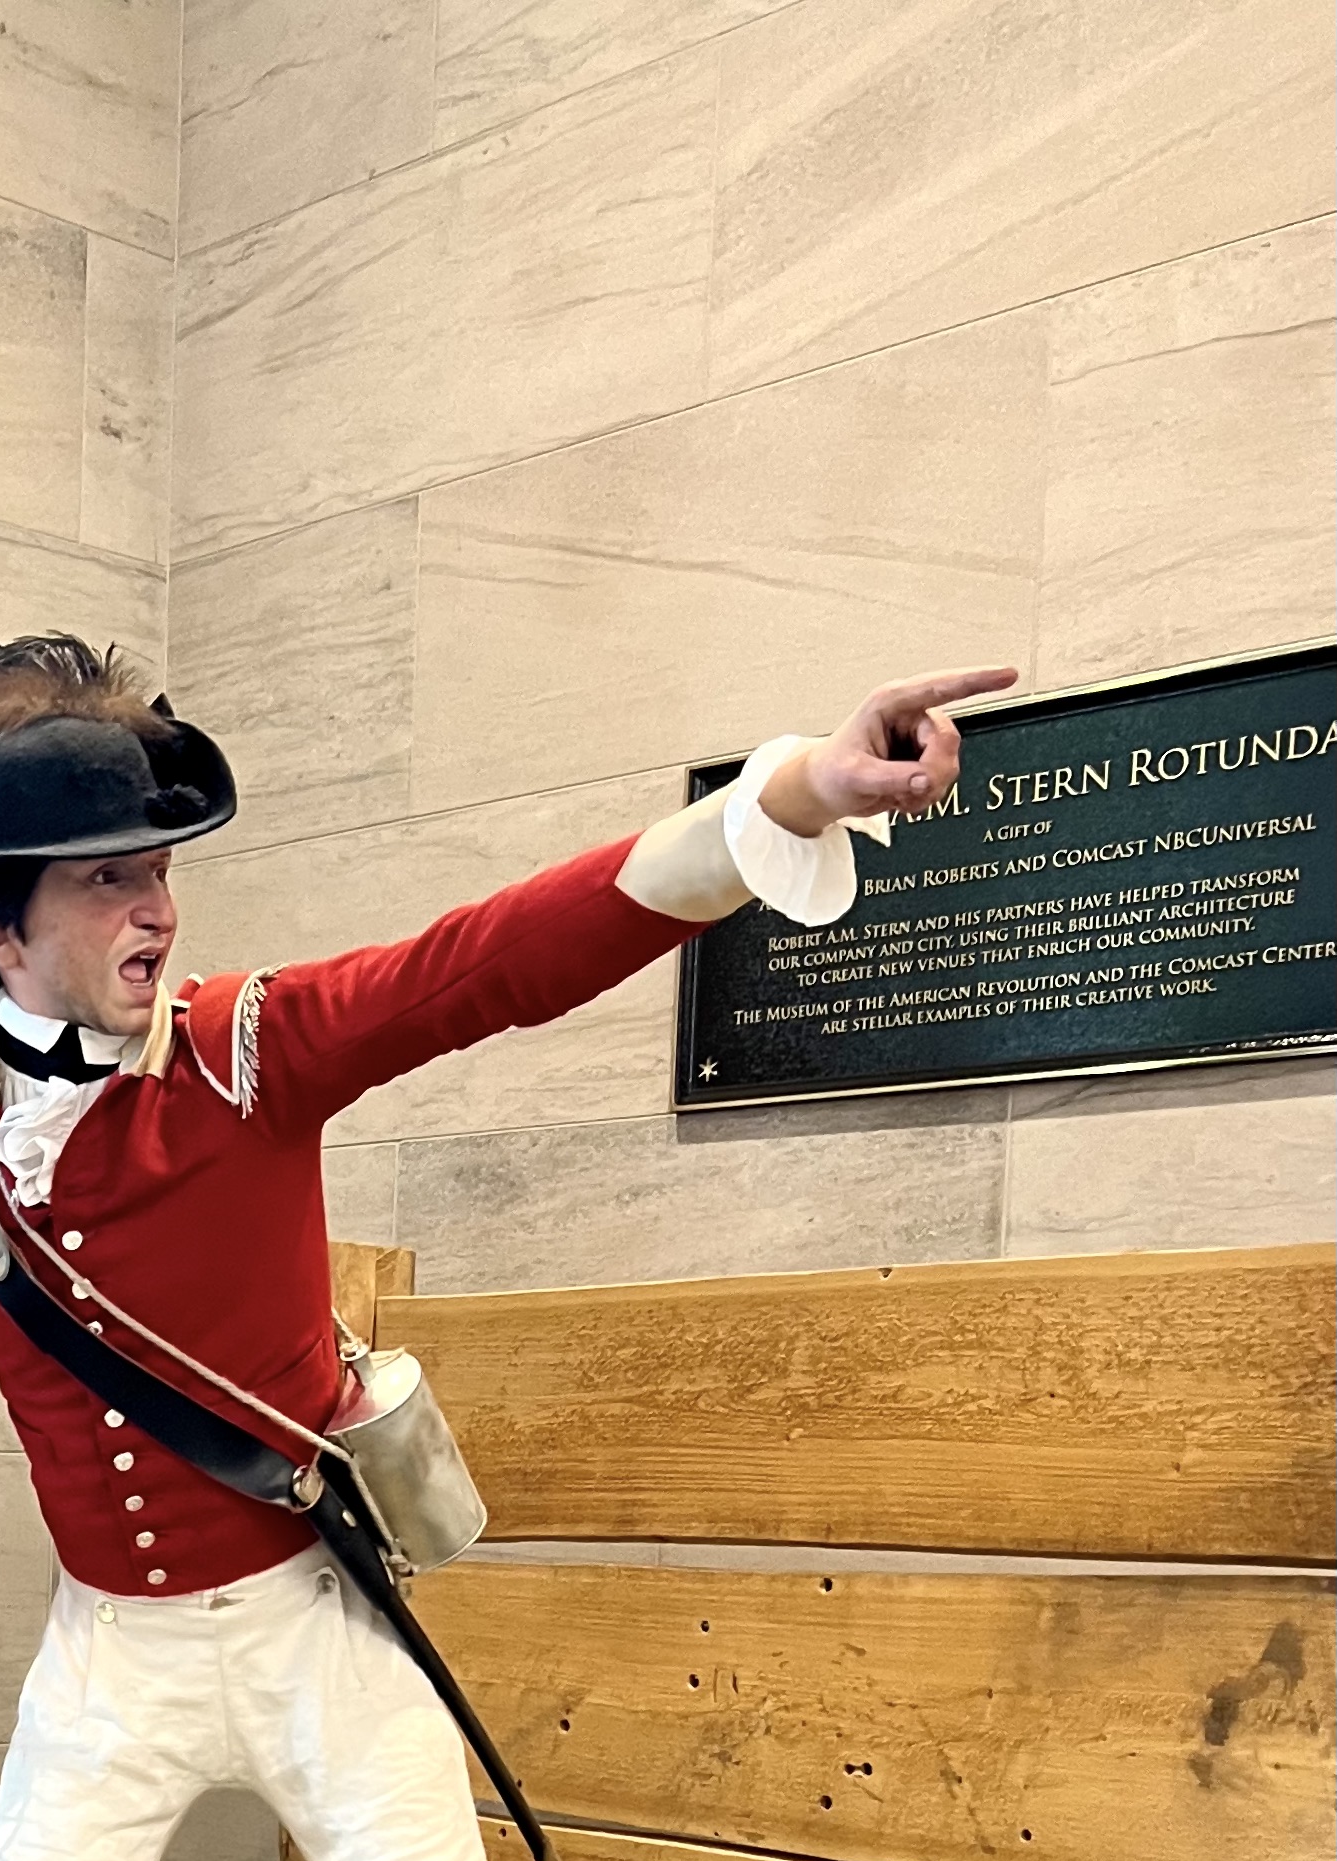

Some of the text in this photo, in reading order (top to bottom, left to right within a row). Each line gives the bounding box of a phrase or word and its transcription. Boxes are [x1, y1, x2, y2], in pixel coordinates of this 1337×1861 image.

[986, 759, 1110, 810] STERN
[1130, 720, 1337, 786] ROTUNDA
[864, 813, 1316, 896] BRIAN ROBERTS AND COMCAST NBCUNIVERSAL
[983, 820, 1052, 842] A GIFT OF
[768, 867, 1300, 952] ROBERT A.M. STERN AND HIS PARTNERS HAVE HELPED TRANSFORM
[768, 888, 1295, 971] OUR COMPANY AND CITY, USING THEIR BRILLIANT ARCHITECTURE
[734, 941, 1336, 1025] THE MUSEUM OF THE AMERICAN REVOLUTION AND THE COMCAST CENTER
[798, 916, 1253, 987] TO CREATE NEW VENUES THAT ENRICH OUR COMMUNITY.
[821, 978, 1217, 1034] ARE STELLAR EXAMPLES OF THEIR CREATIVE WORK.
